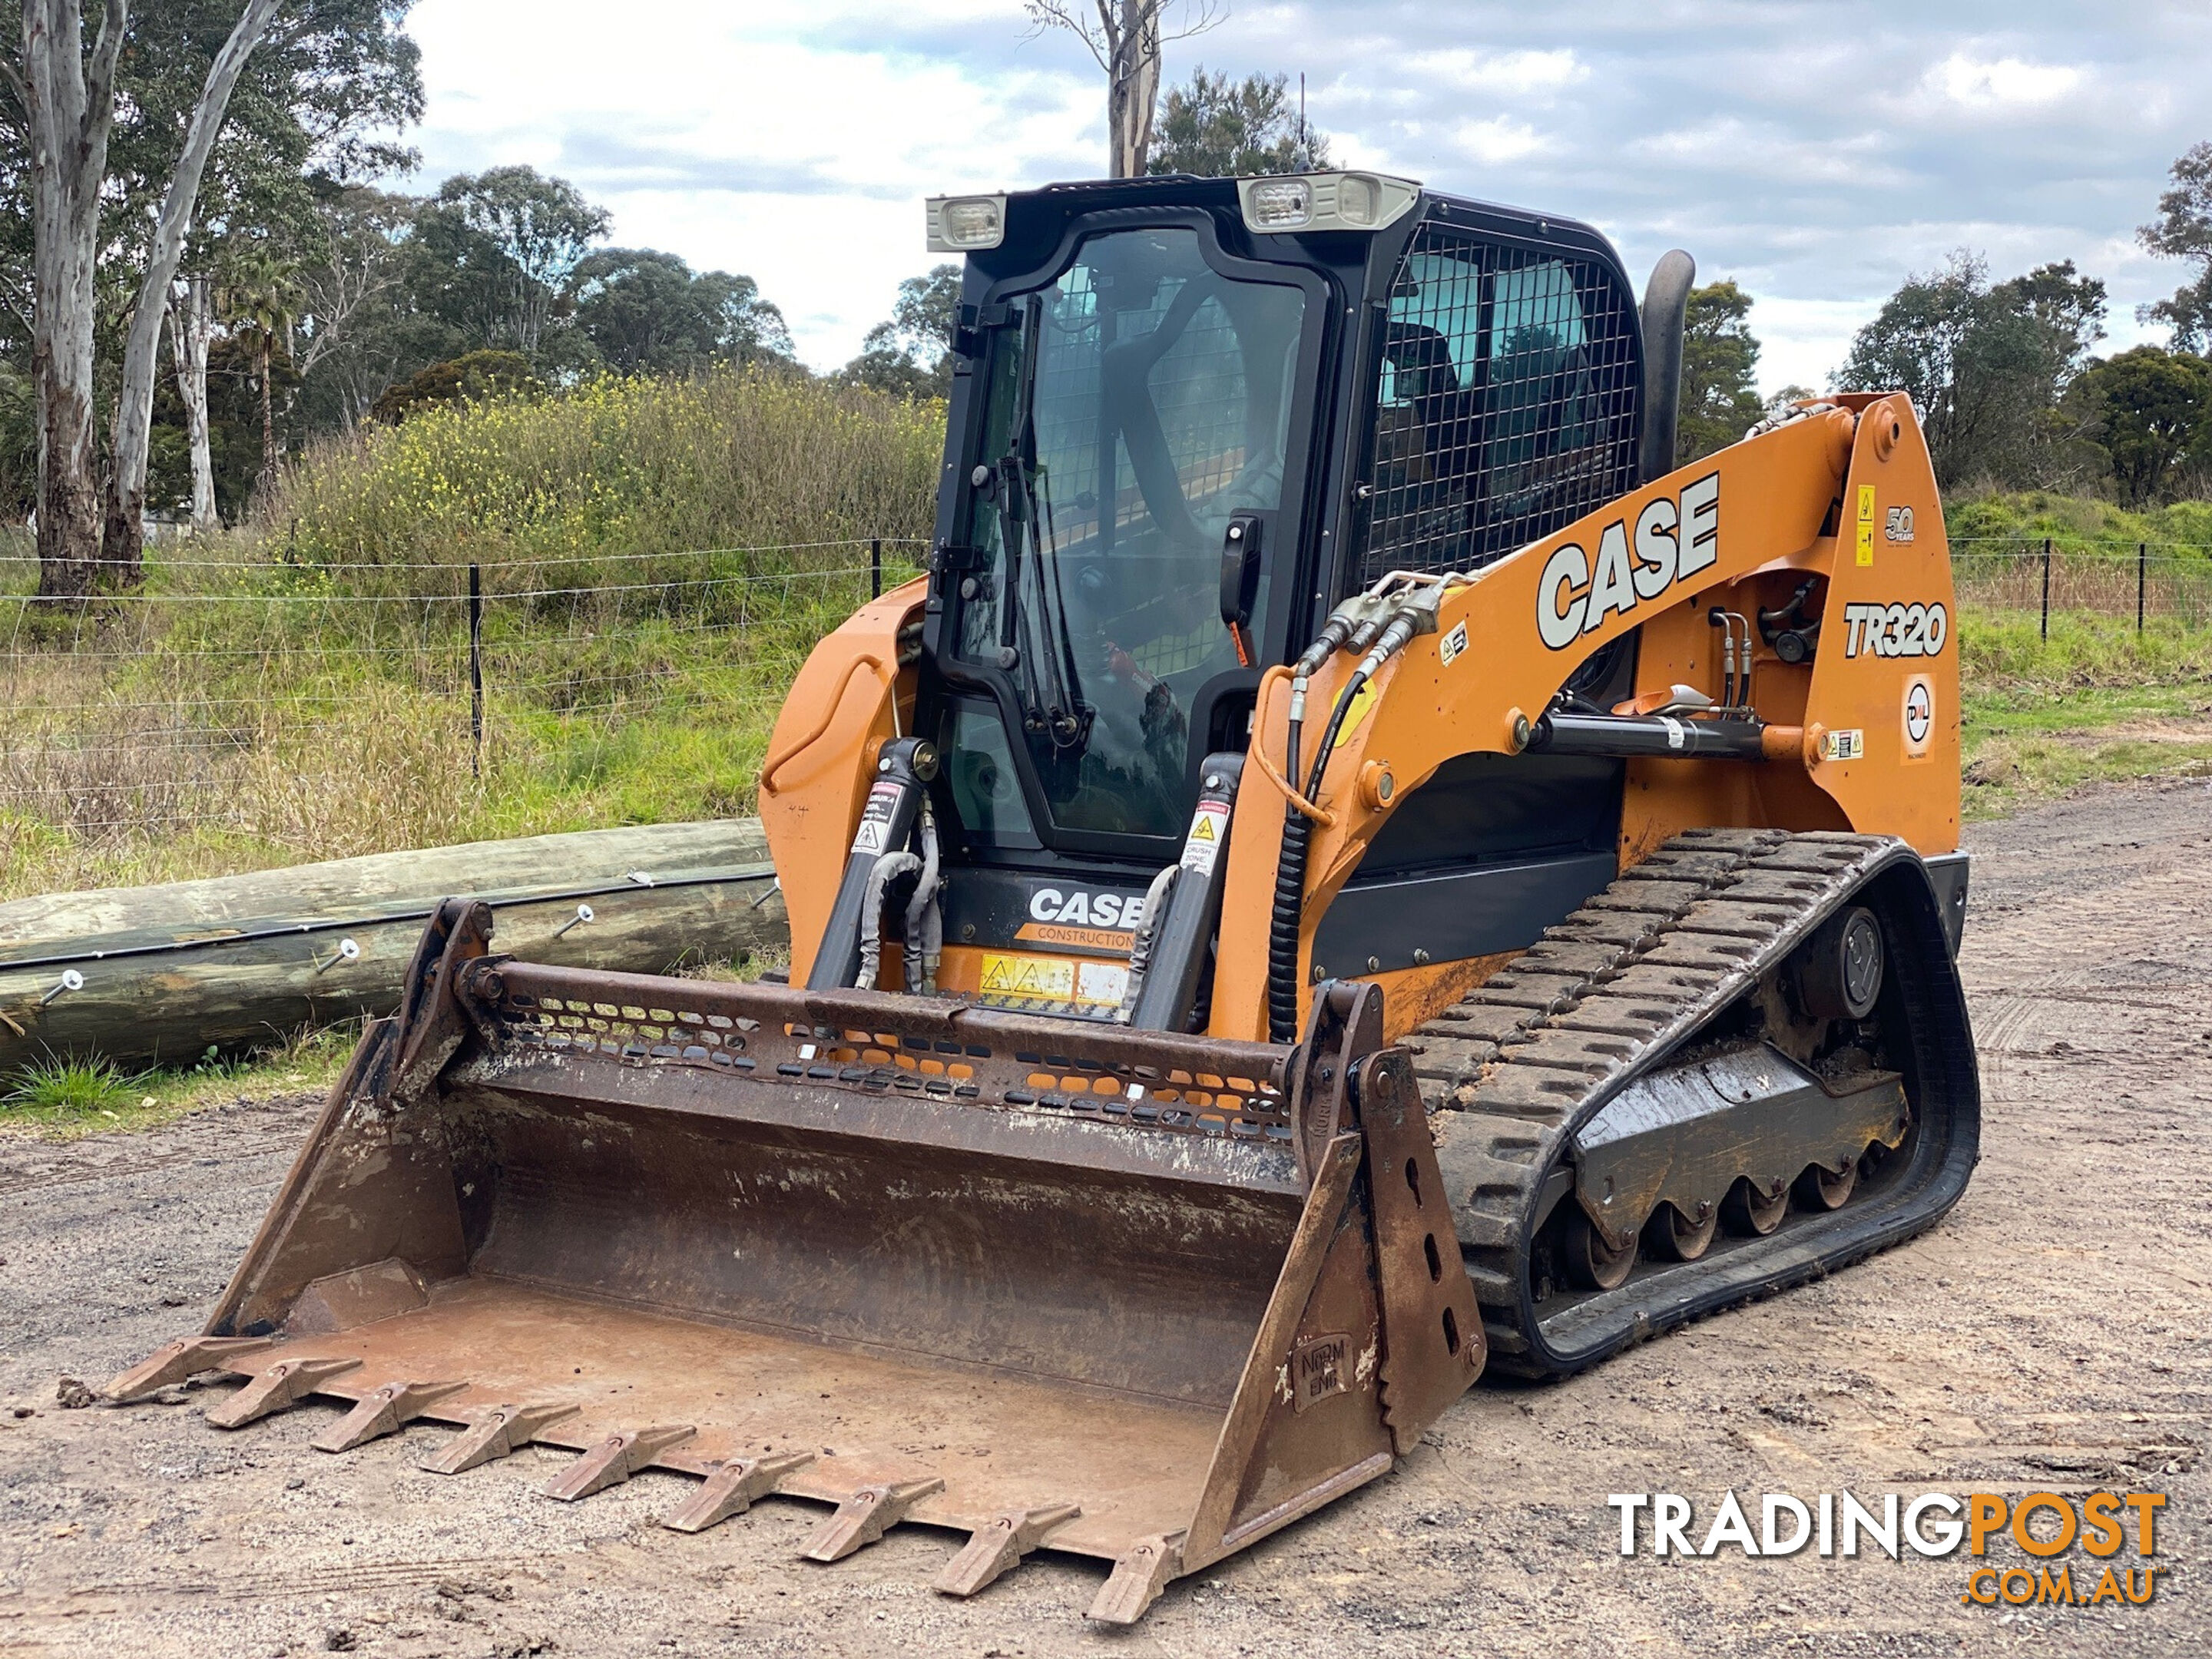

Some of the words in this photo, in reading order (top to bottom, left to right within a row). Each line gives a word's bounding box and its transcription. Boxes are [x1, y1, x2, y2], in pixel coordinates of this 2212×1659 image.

[1885, 505, 1914, 541] 50
[1896, 532, 1914, 541] YEARS
[1537, 470, 1720, 651] CASE
[1843, 601, 1947, 659] TR320
[1186, 846, 1211, 859] CRUSH
[1029, 888, 1146, 929] CASE
[1038, 927, 1134, 947] CONSTRUCTION
